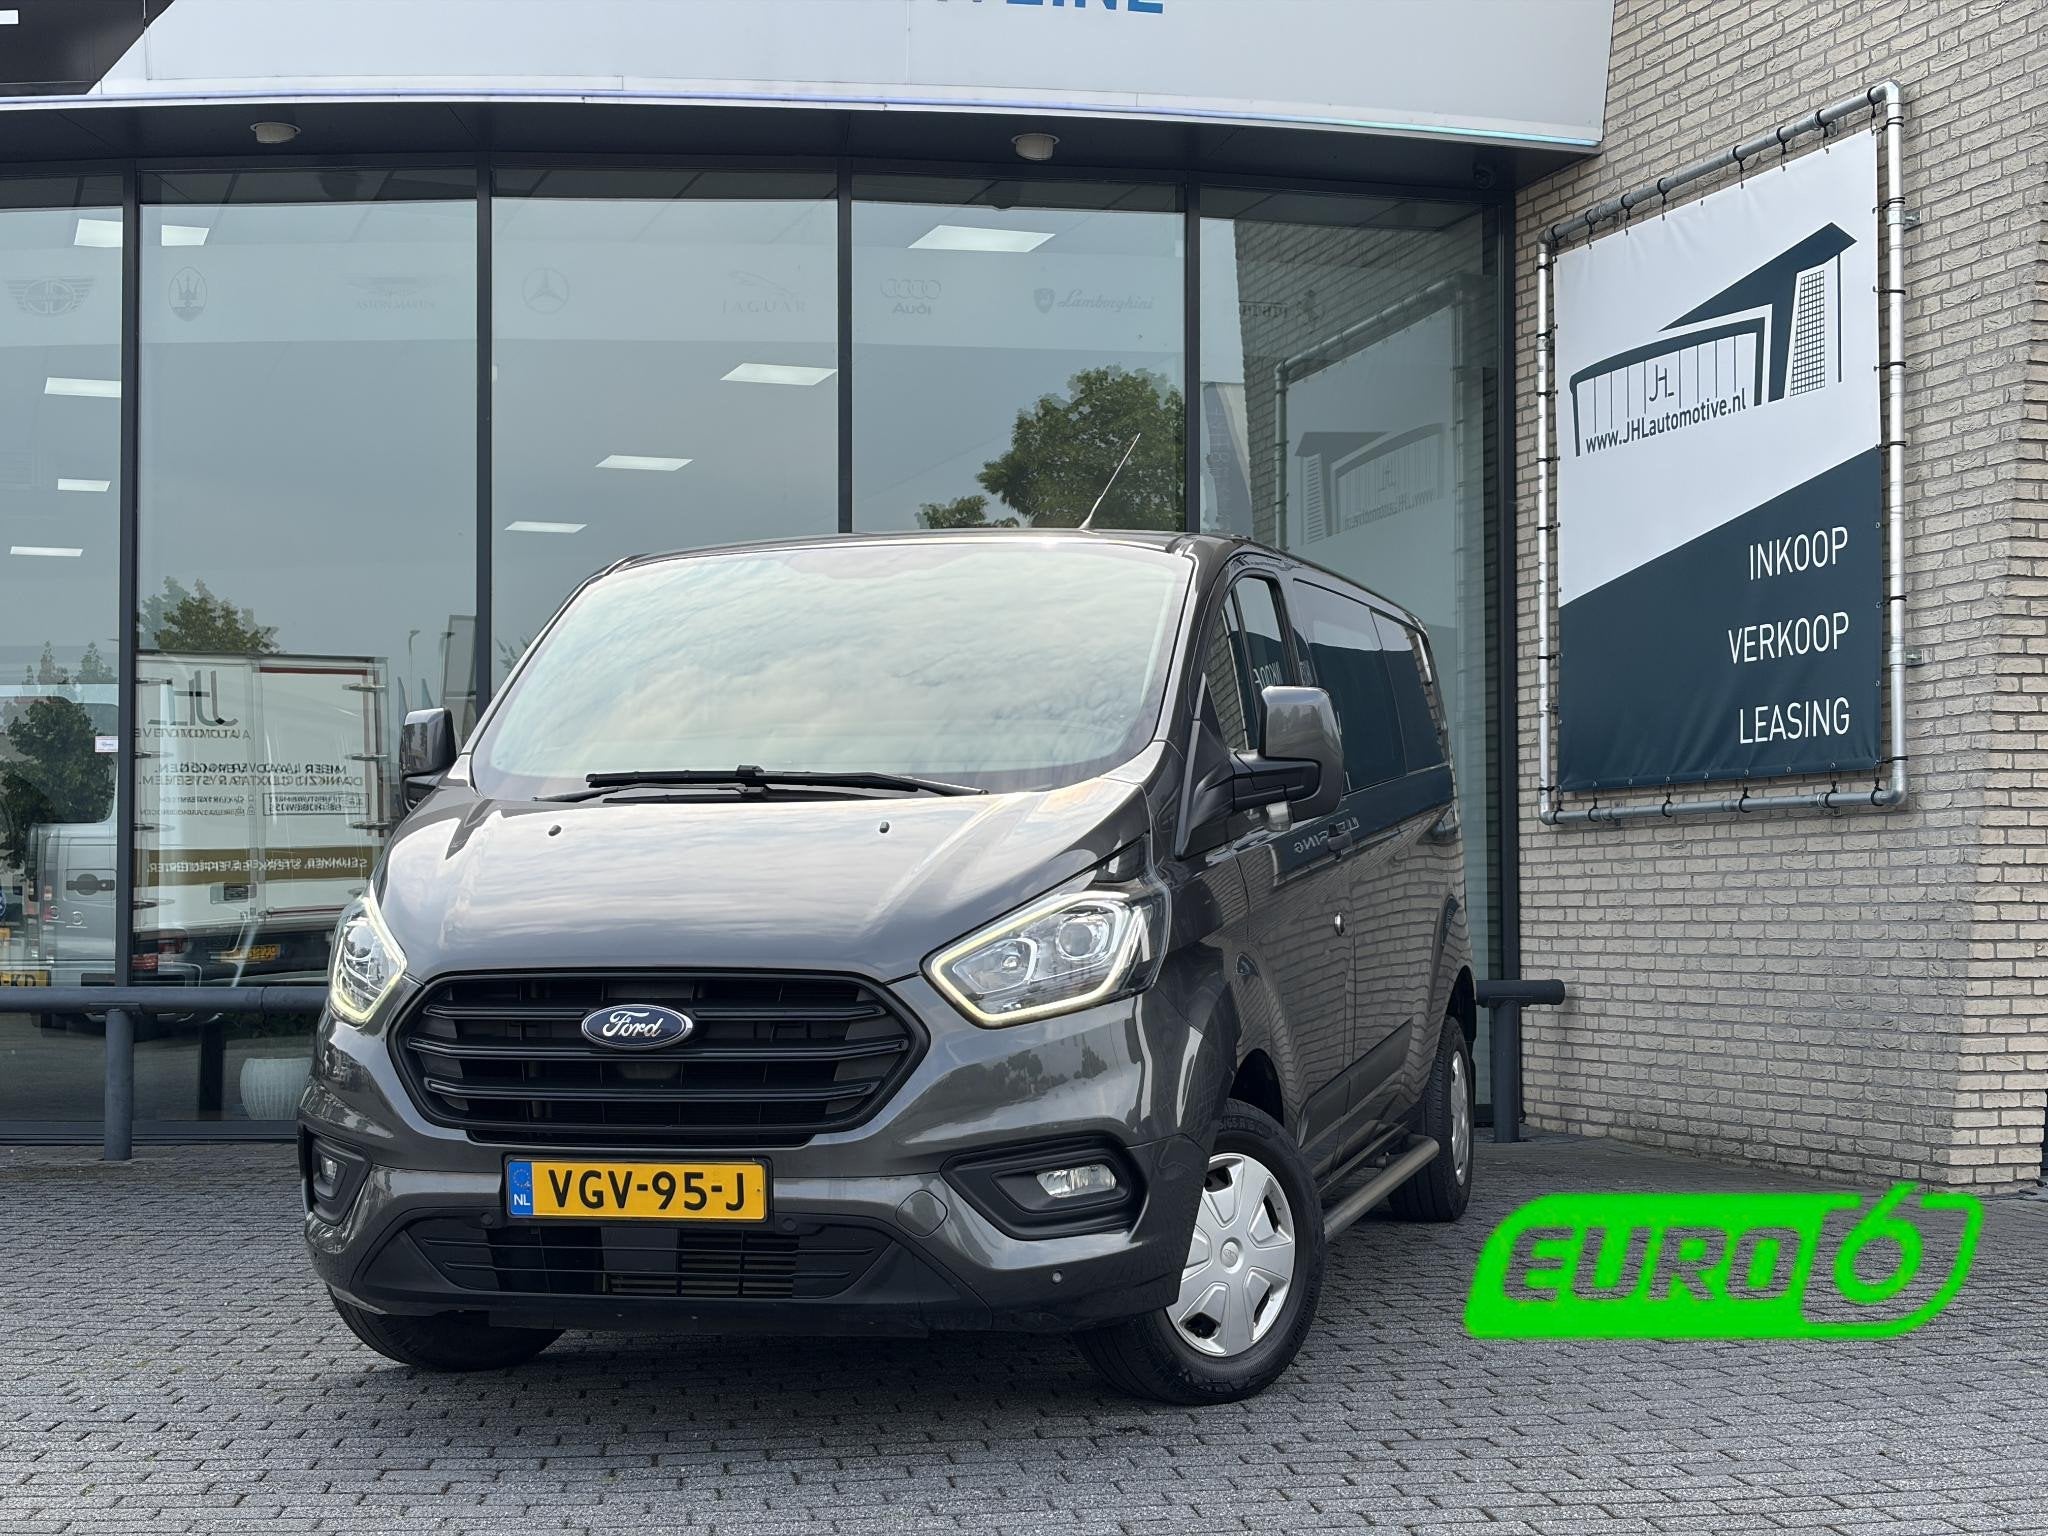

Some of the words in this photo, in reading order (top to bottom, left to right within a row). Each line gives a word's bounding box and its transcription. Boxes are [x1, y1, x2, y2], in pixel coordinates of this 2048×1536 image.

[721, 299, 807, 314] JAGUAR
[892, 302, 934, 315] Audi
[1056, 288, 1155, 313] Lamborghini
[1585, 387, 1746, 454] www.JHLautomotive.nl
[1749, 526, 1848, 581] INKOOP
[1728, 611, 1850, 664] VERKOOP
[1739, 696, 1850, 744] LEASING
[602, 1010, 665, 1037] Ford
[513, 1194, 531, 1206] NL
[548, 1169, 745, 1211] VGV-95-J
